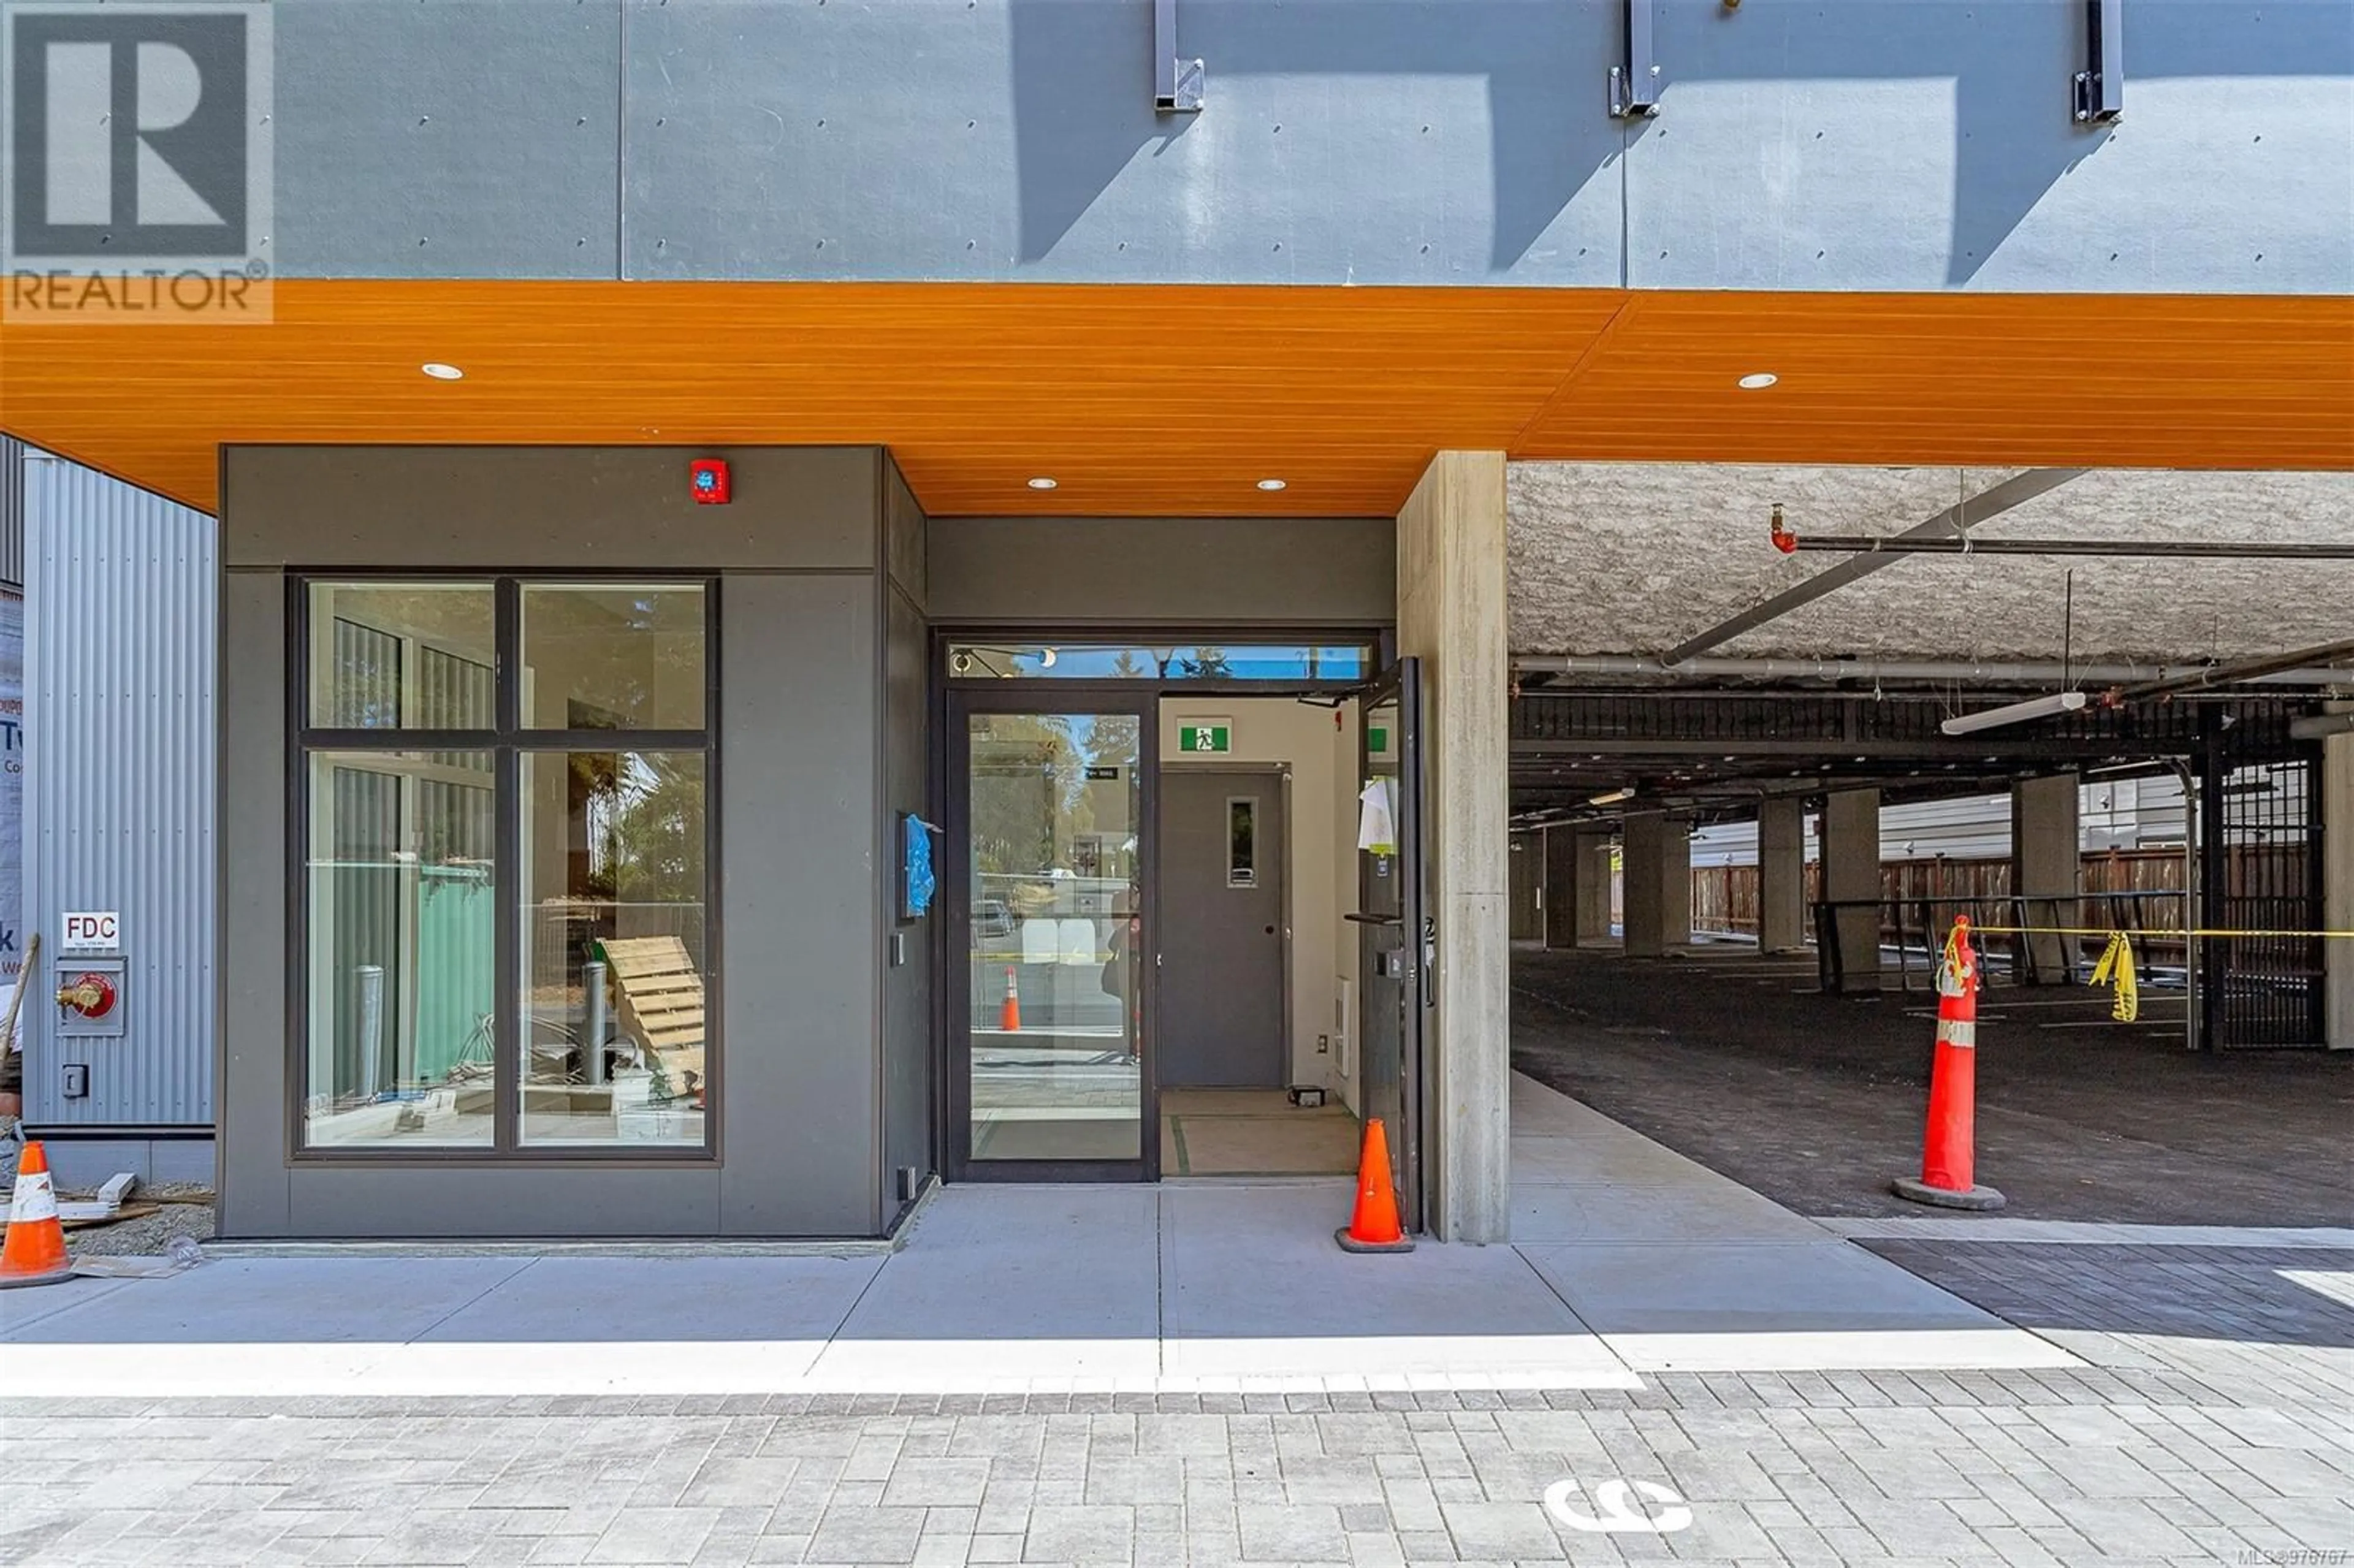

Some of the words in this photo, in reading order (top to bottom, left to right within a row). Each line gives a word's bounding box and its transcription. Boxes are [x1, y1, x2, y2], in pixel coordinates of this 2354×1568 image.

[0, 720, 23, 751] T
[4, 759, 22, 774] Co
[67, 916, 115, 938] FDC
